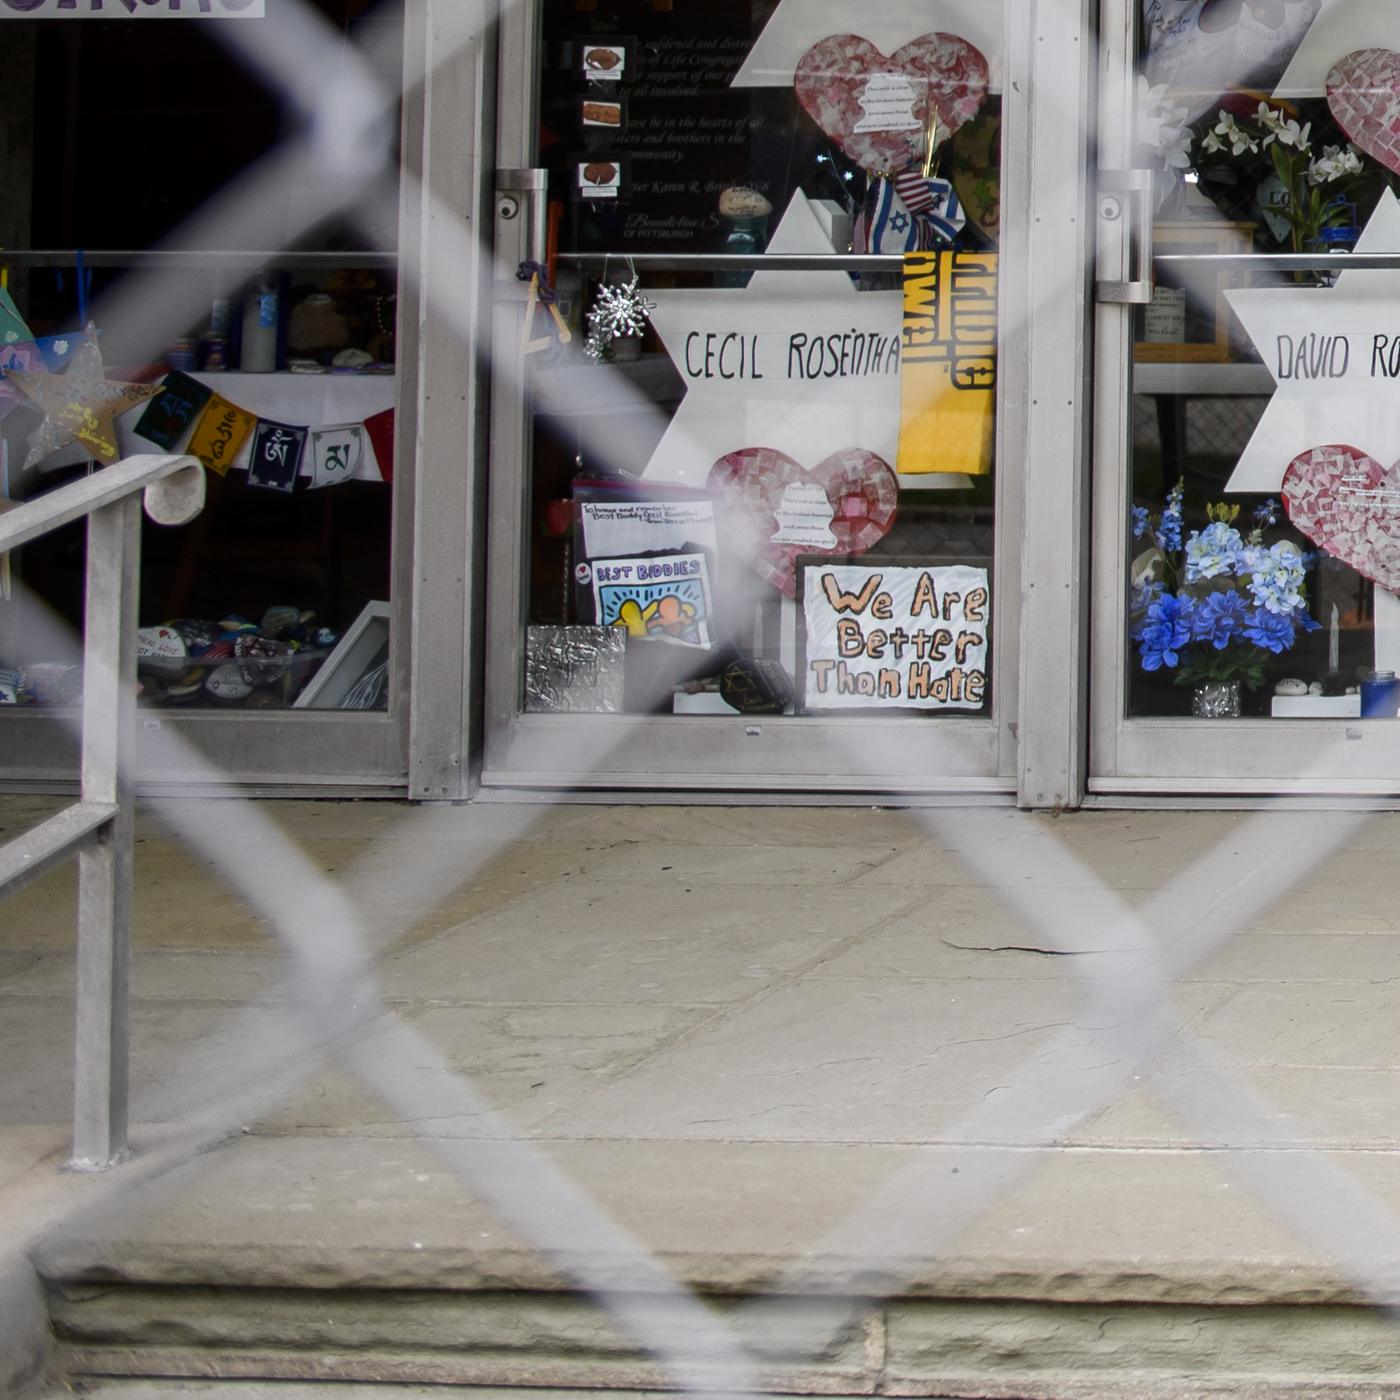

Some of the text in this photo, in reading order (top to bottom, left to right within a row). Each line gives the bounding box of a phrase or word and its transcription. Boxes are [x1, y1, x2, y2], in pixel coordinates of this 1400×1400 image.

[686, 328, 899, 380] CECIL ROSENTHA
[1277, 333, 1349, 379] DAVID
[821, 572, 988, 620] We Are
[837, 619, 983, 663] Better
[811, 660, 986, 702] Than Hate
